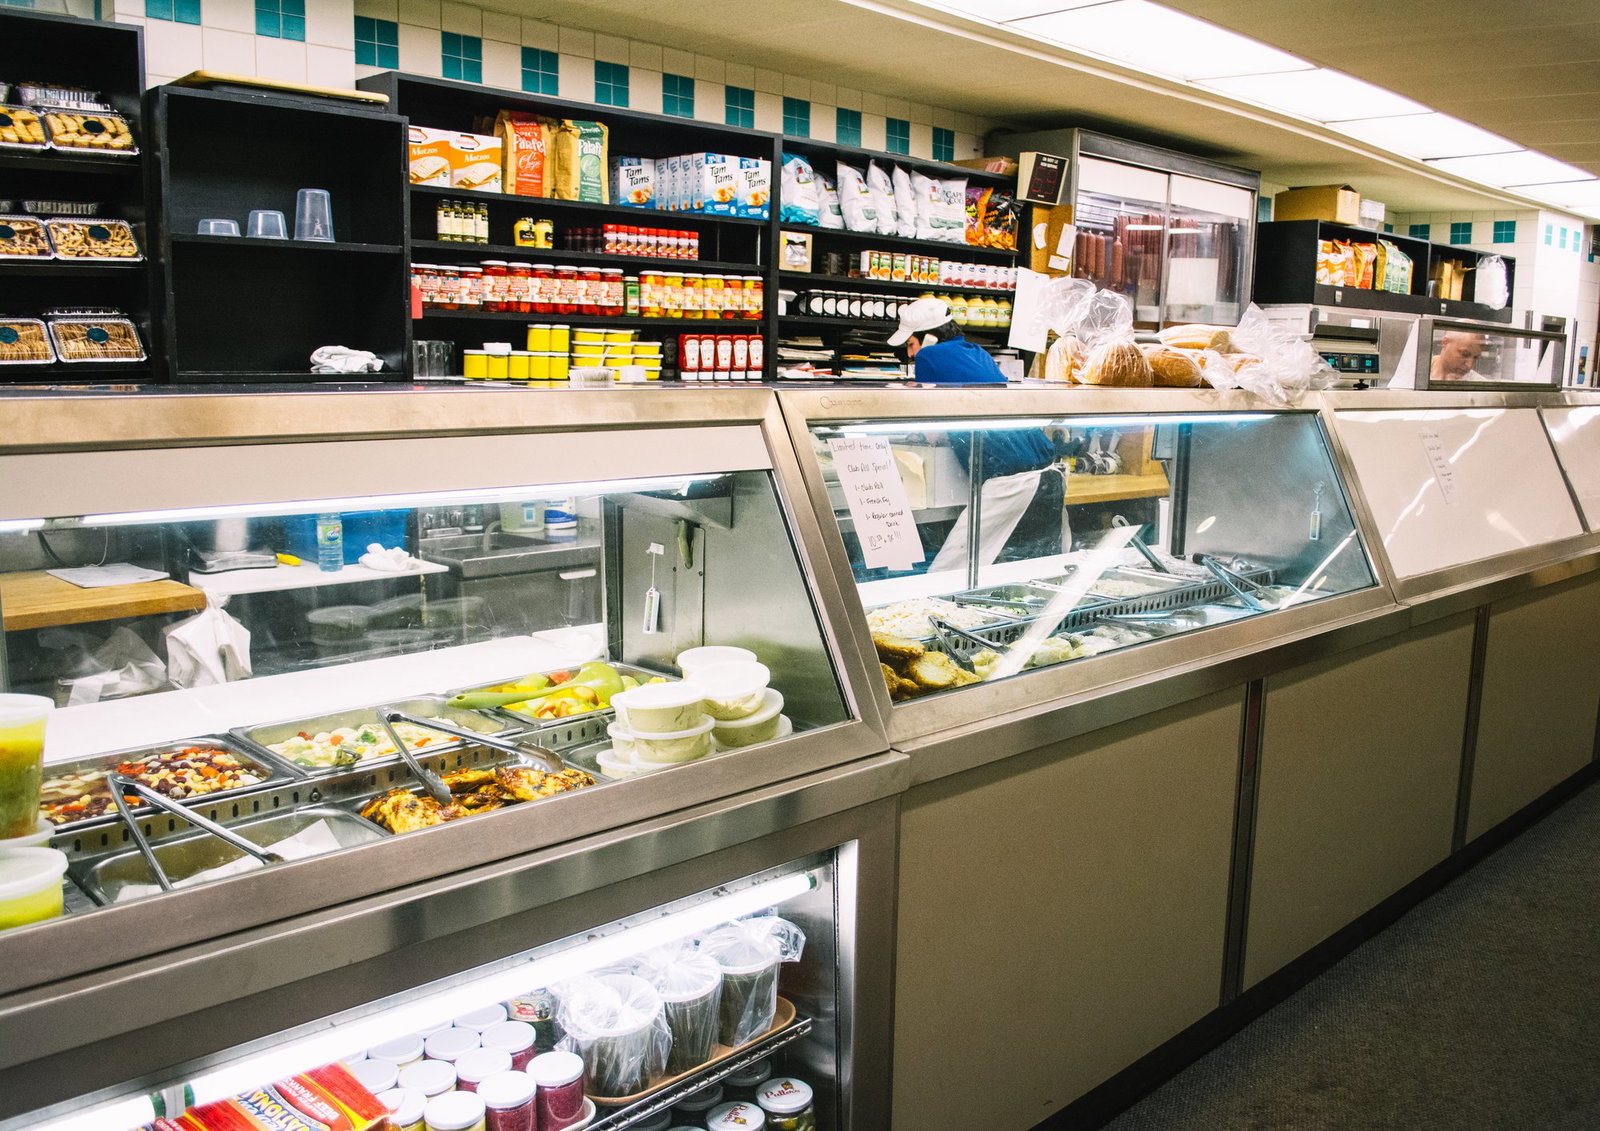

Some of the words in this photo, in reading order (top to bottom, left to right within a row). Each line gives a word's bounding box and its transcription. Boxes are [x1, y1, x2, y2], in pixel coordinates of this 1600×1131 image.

[411, 146, 438, 156] Matzos
[513, 134, 547, 157] Falafel
[464, 153, 490, 163] Matzos
[624, 168, 643, 178] Tam
[710, 166, 727, 176] Tam
[744, 170, 760, 181] Tam
[630, 175, 650, 187] Tams
[714, 174, 733, 185] Tams
[748, 178, 766, 189] Tams
[314, 1099, 340, 1120] BEEF
